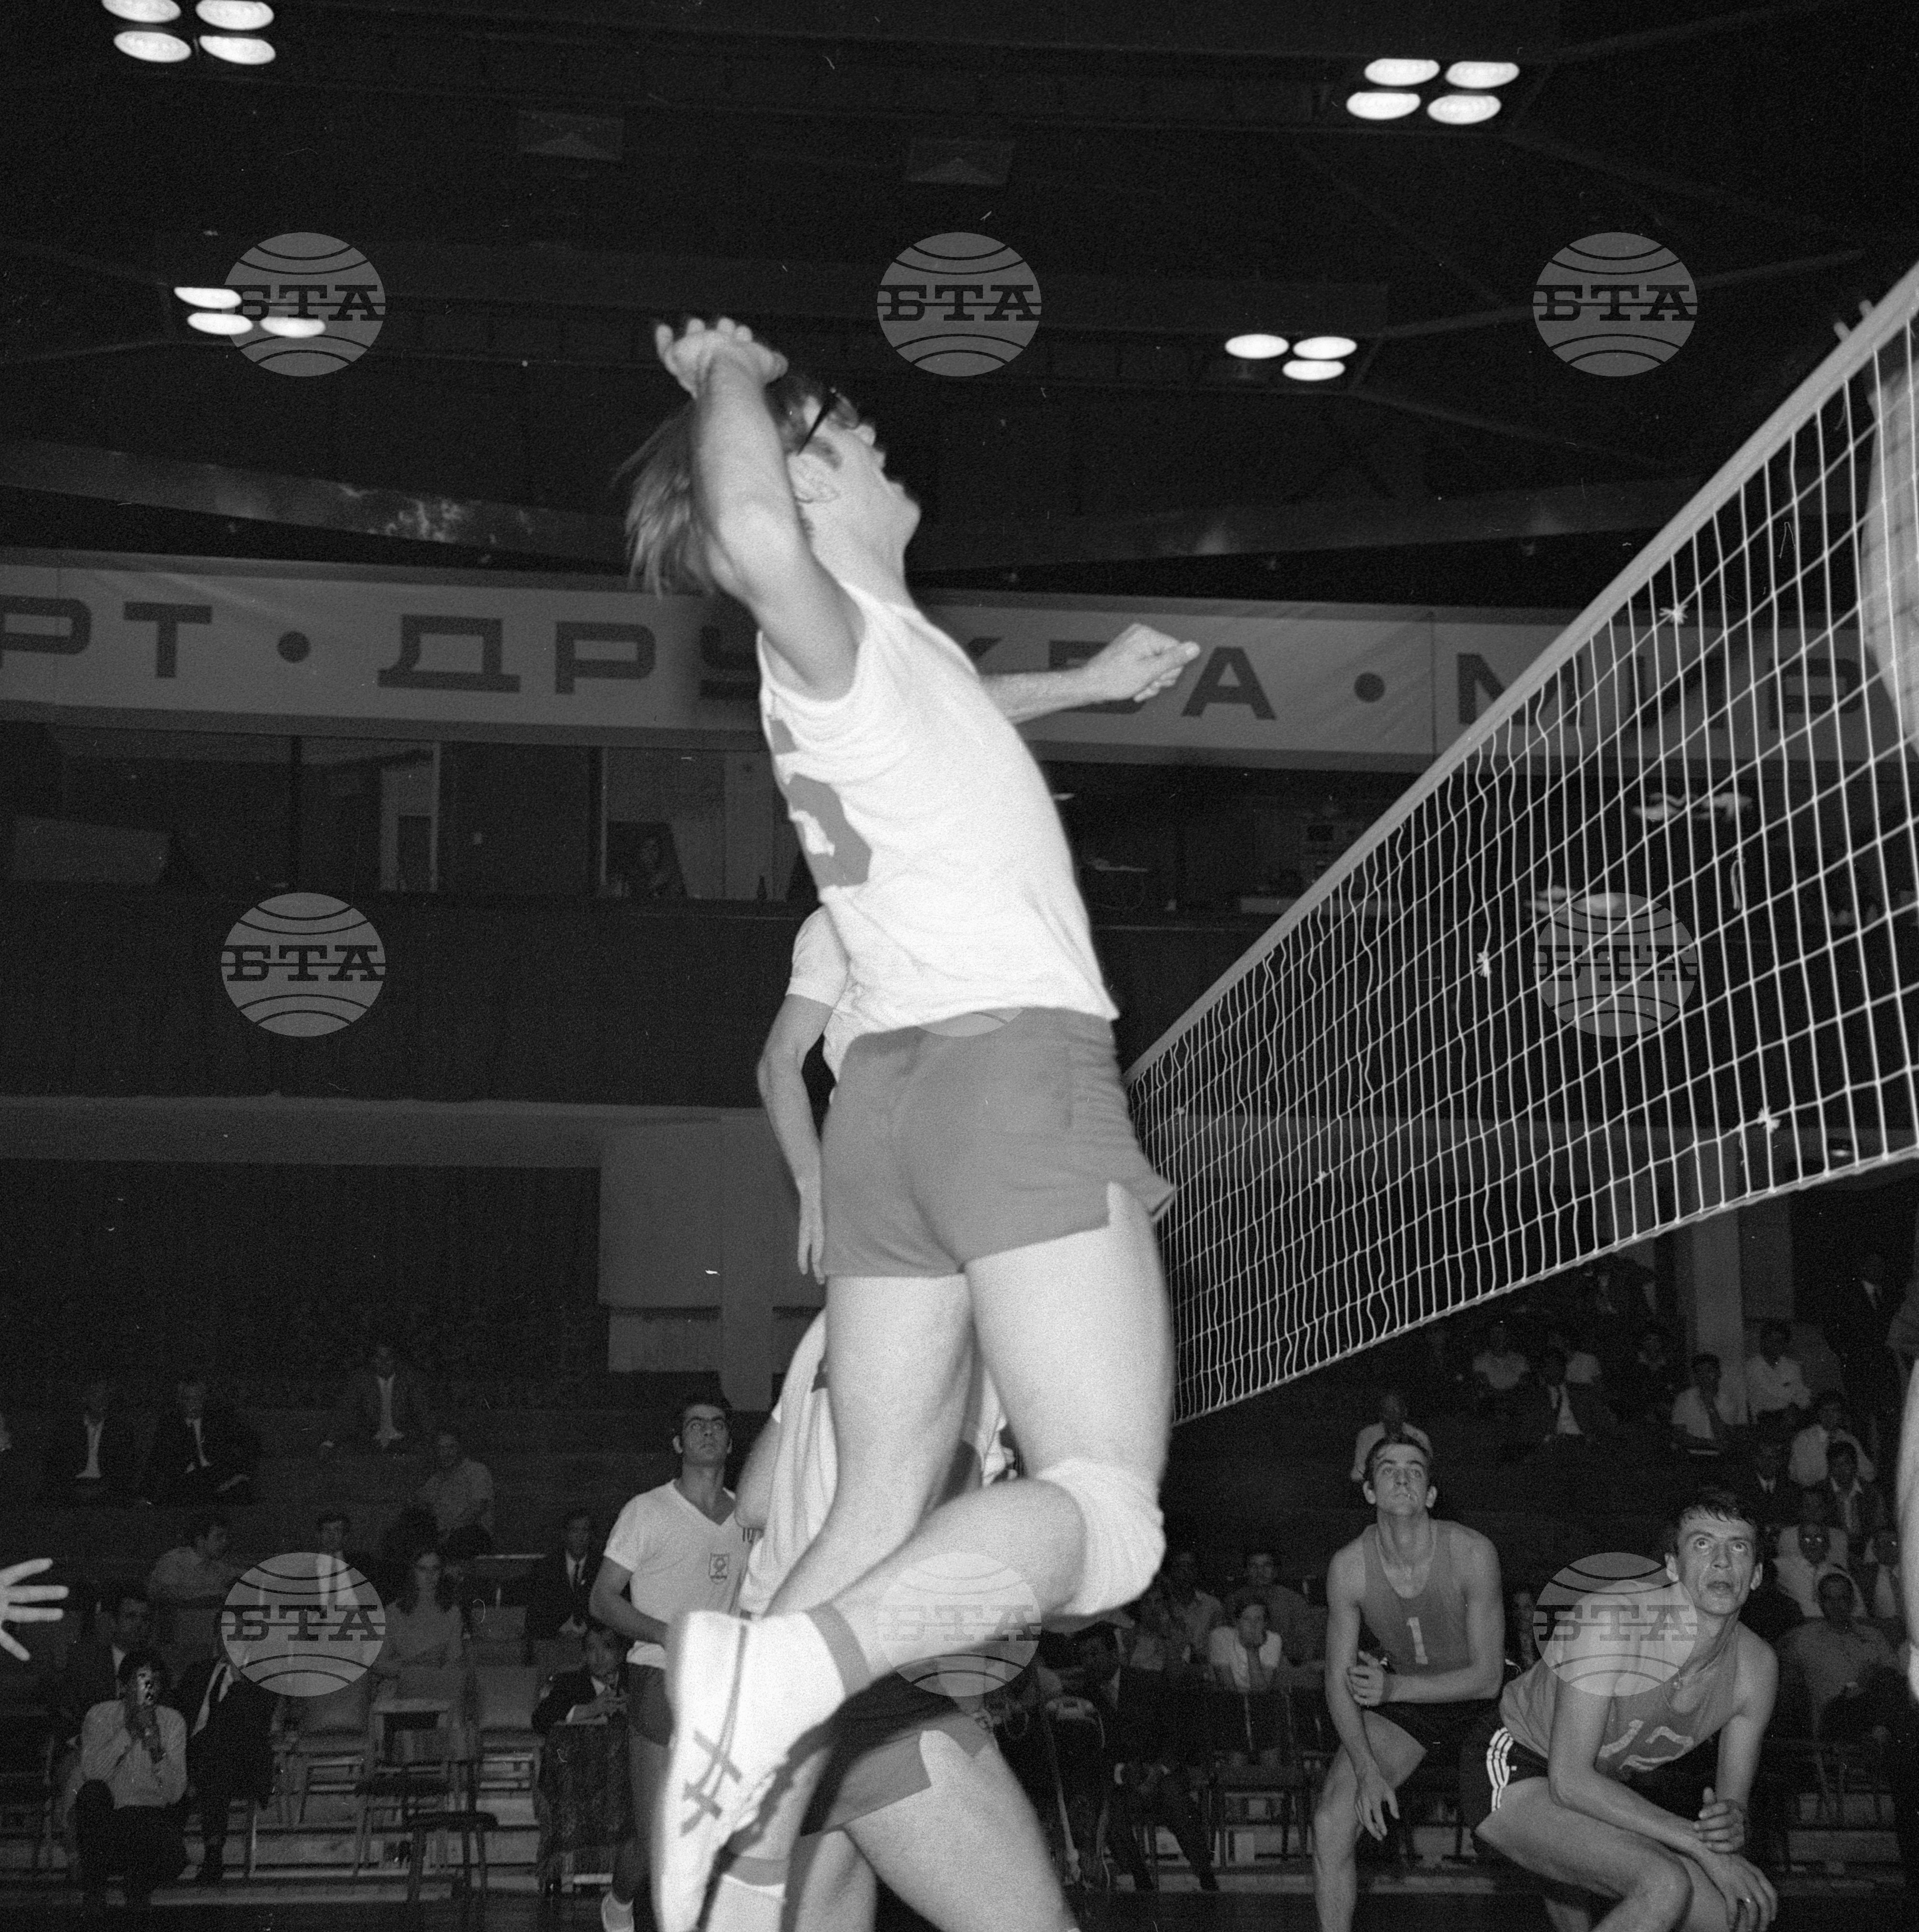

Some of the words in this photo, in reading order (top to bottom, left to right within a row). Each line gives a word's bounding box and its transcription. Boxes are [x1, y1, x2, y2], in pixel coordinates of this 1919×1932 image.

[378, 613, 1276, 720] ДРУА
[1406, 1617, 1428, 1665] 1
[1597, 1719, 1694, 1772] 12
